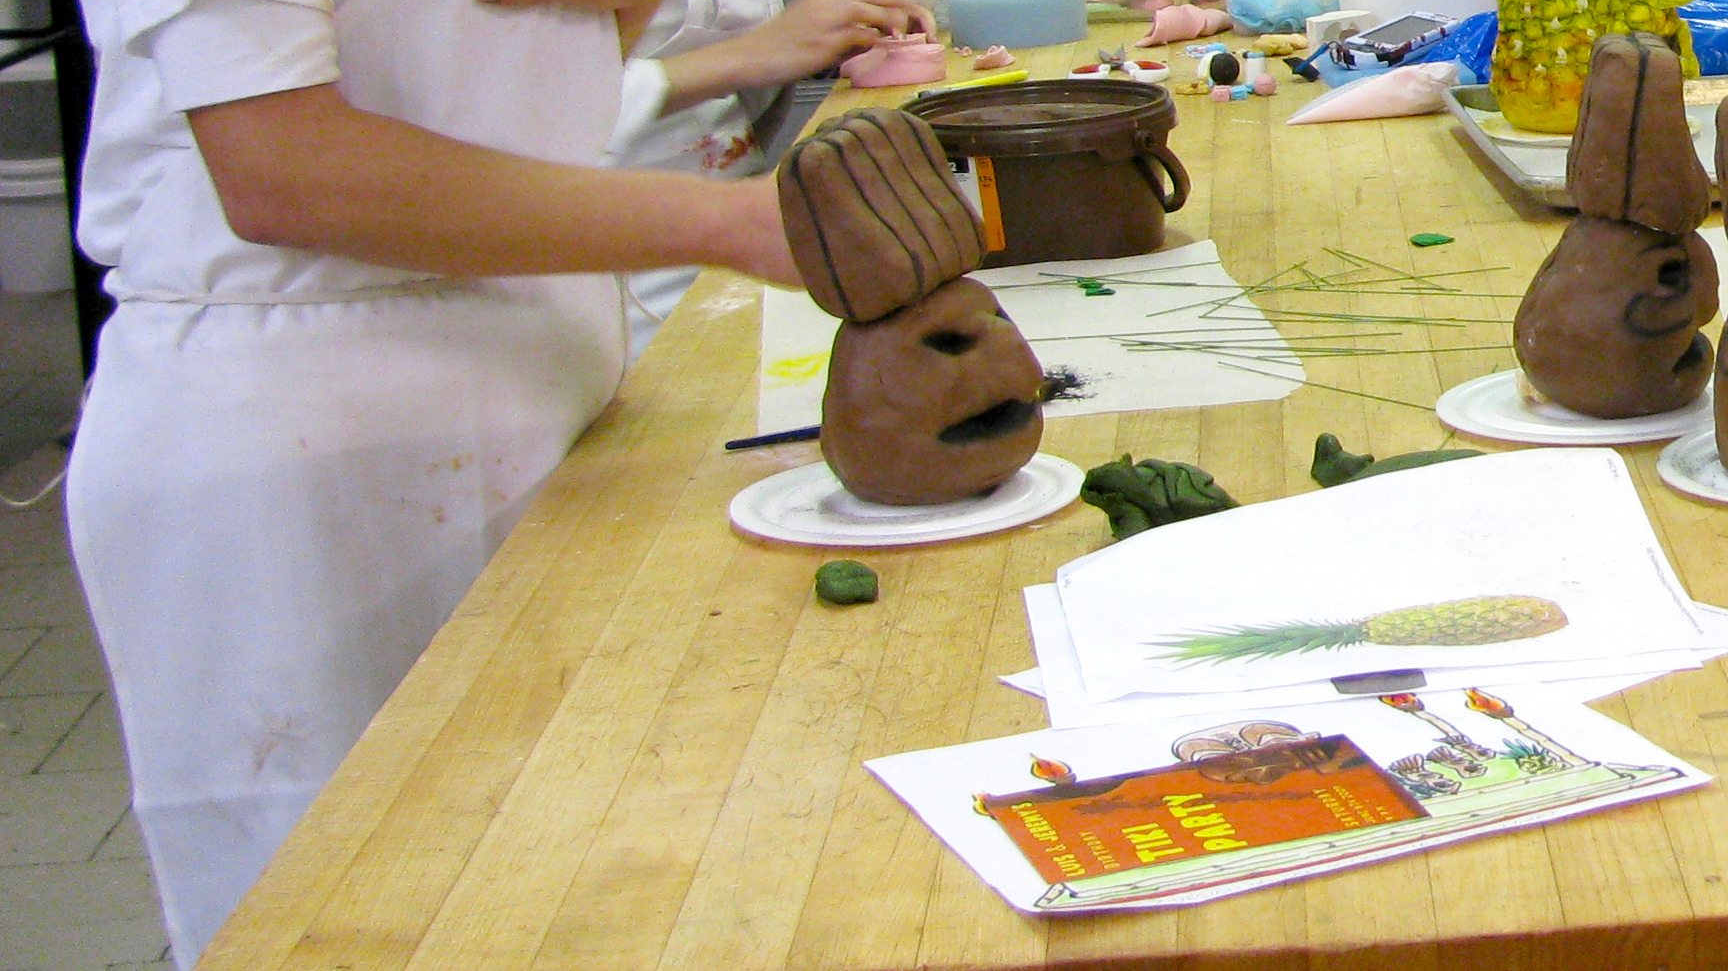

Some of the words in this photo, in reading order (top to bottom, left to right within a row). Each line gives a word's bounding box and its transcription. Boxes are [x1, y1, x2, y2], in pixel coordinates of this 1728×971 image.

[1011, 801, 1058, 842] JEREMY'S
[1163, 793, 1248, 851] PARTY
[1312, 788, 1360, 827] SATURDAY
[1044, 843, 1067, 853] &
[1079, 831, 1120, 870] BIRTHDAY
[1121, 823, 1186, 863] TIKI
[1053, 853, 1086, 877] LUIS
